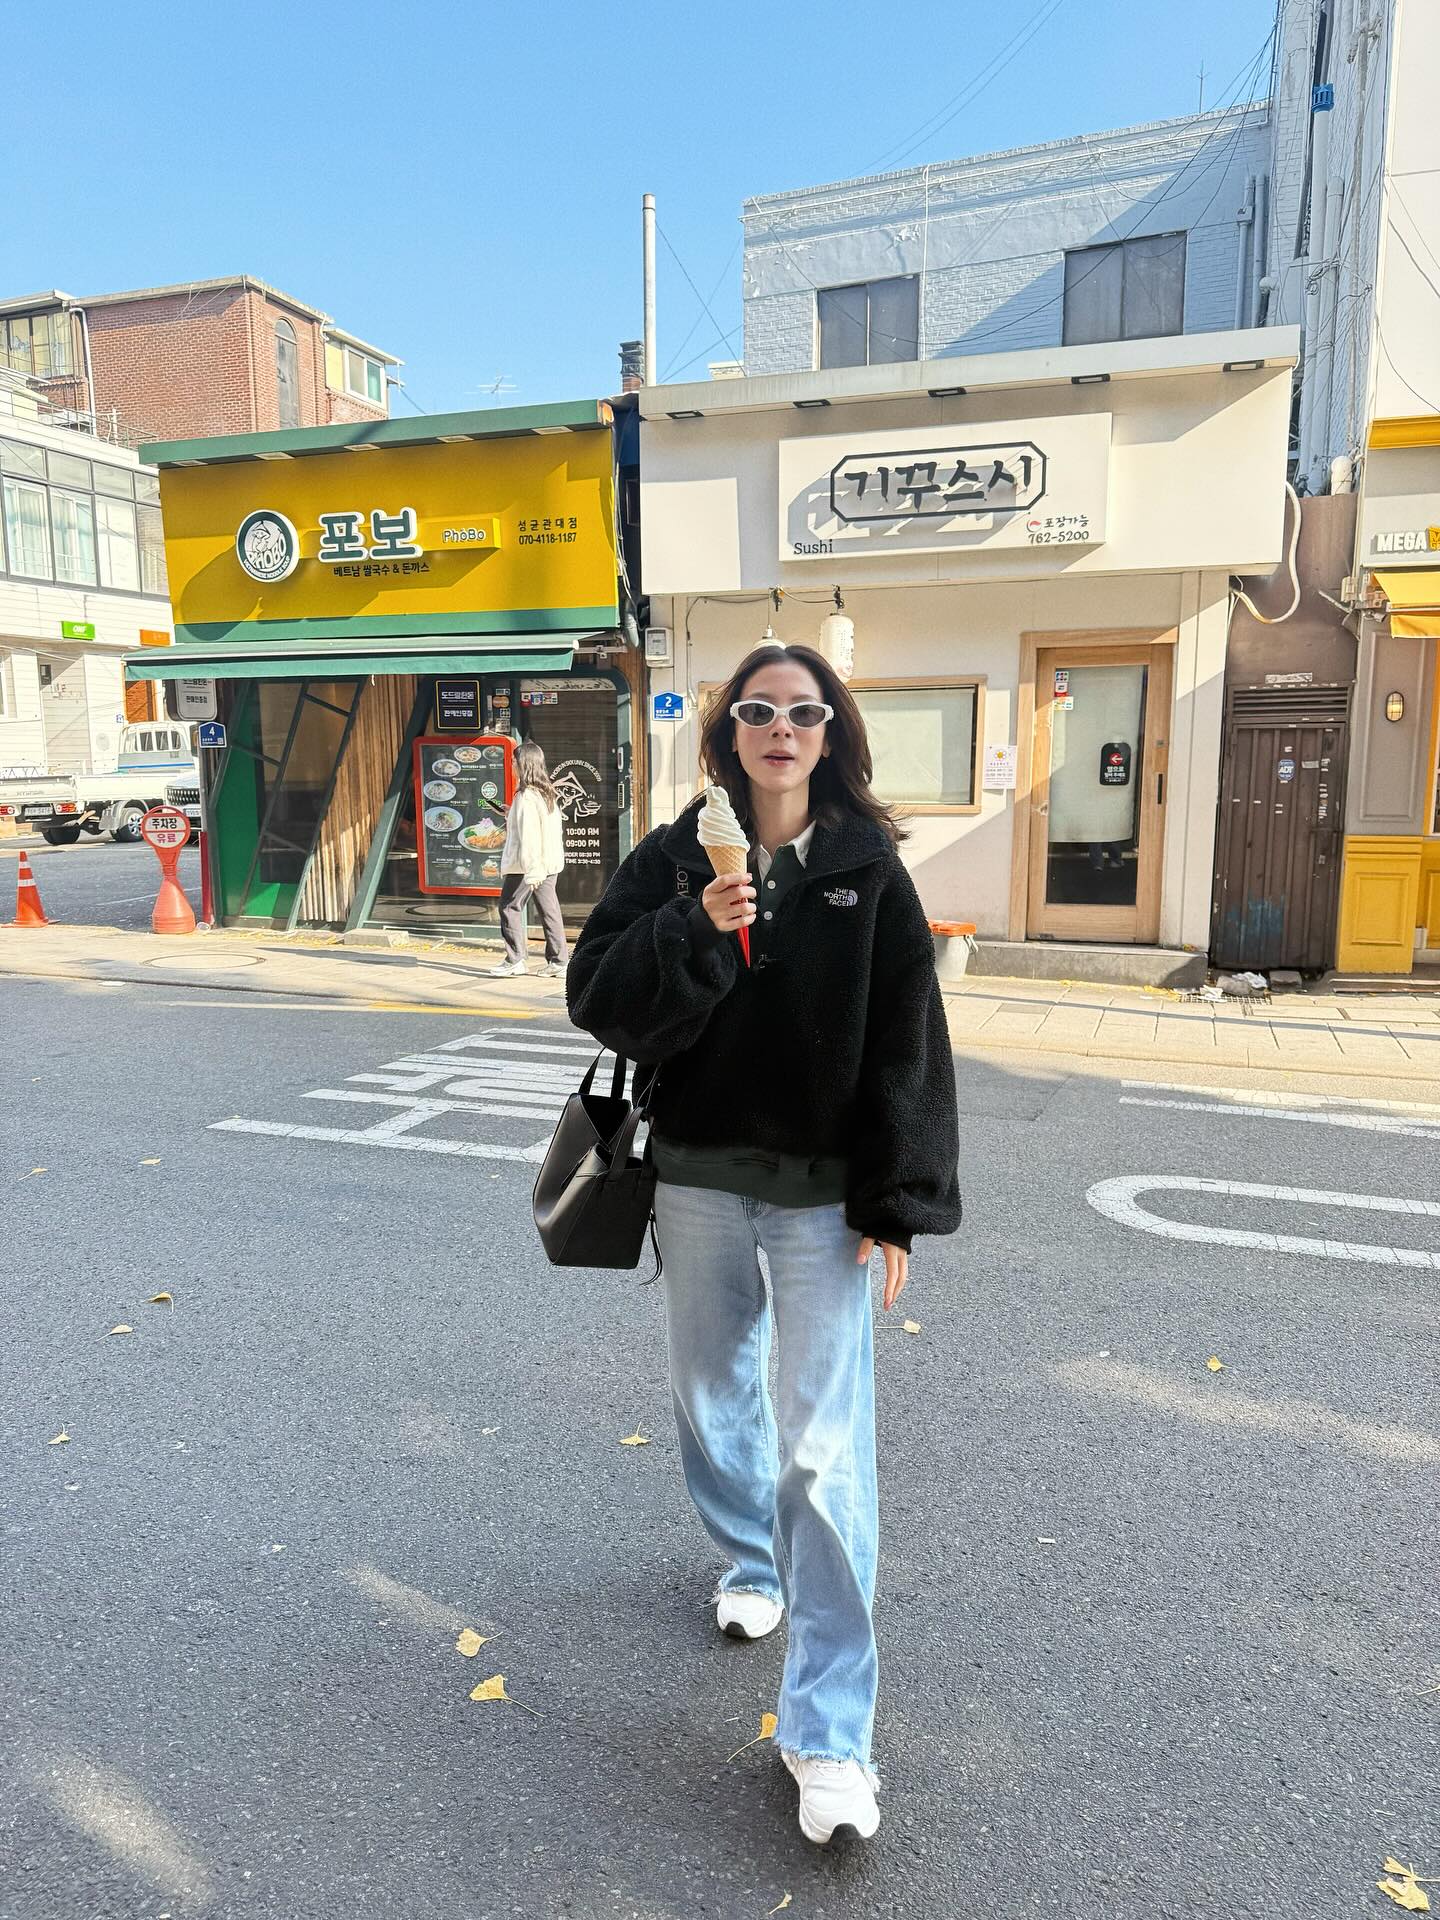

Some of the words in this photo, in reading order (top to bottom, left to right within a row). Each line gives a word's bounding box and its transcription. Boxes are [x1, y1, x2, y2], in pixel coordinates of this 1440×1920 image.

[844, 455, 1032, 512] 기꾸스시
[518, 517, 577, 532] 성균관대점
[1044, 514, 1089, 528] 포장가능
[319, 508, 422, 561] 포보
[1028, 530, 1089, 545] 762-5200
[793, 539, 834, 555] Sushi
[1376, 531, 1427, 552] MEGA
[333, 565, 361, 577] 베트남
[363, 563, 390, 577] 쌀국수
[392, 563, 400, 574] &
[402, 562, 430, 575] 돈까스
[665, 696, 672, 707] 2
[208, 726, 215, 736] 4
[151, 817, 178, 830] 주차장
[156, 832, 177, 844] 유료
[566, 827, 586, 836] 10:00
[587, 827, 600, 836] AM
[565, 839, 587, 848] 09:00
[588, 839, 600, 848] PM
[824, 891, 848, 901] NORTH
[835, 887, 849, 895] THE
[829, 899, 847, 907] FACE
